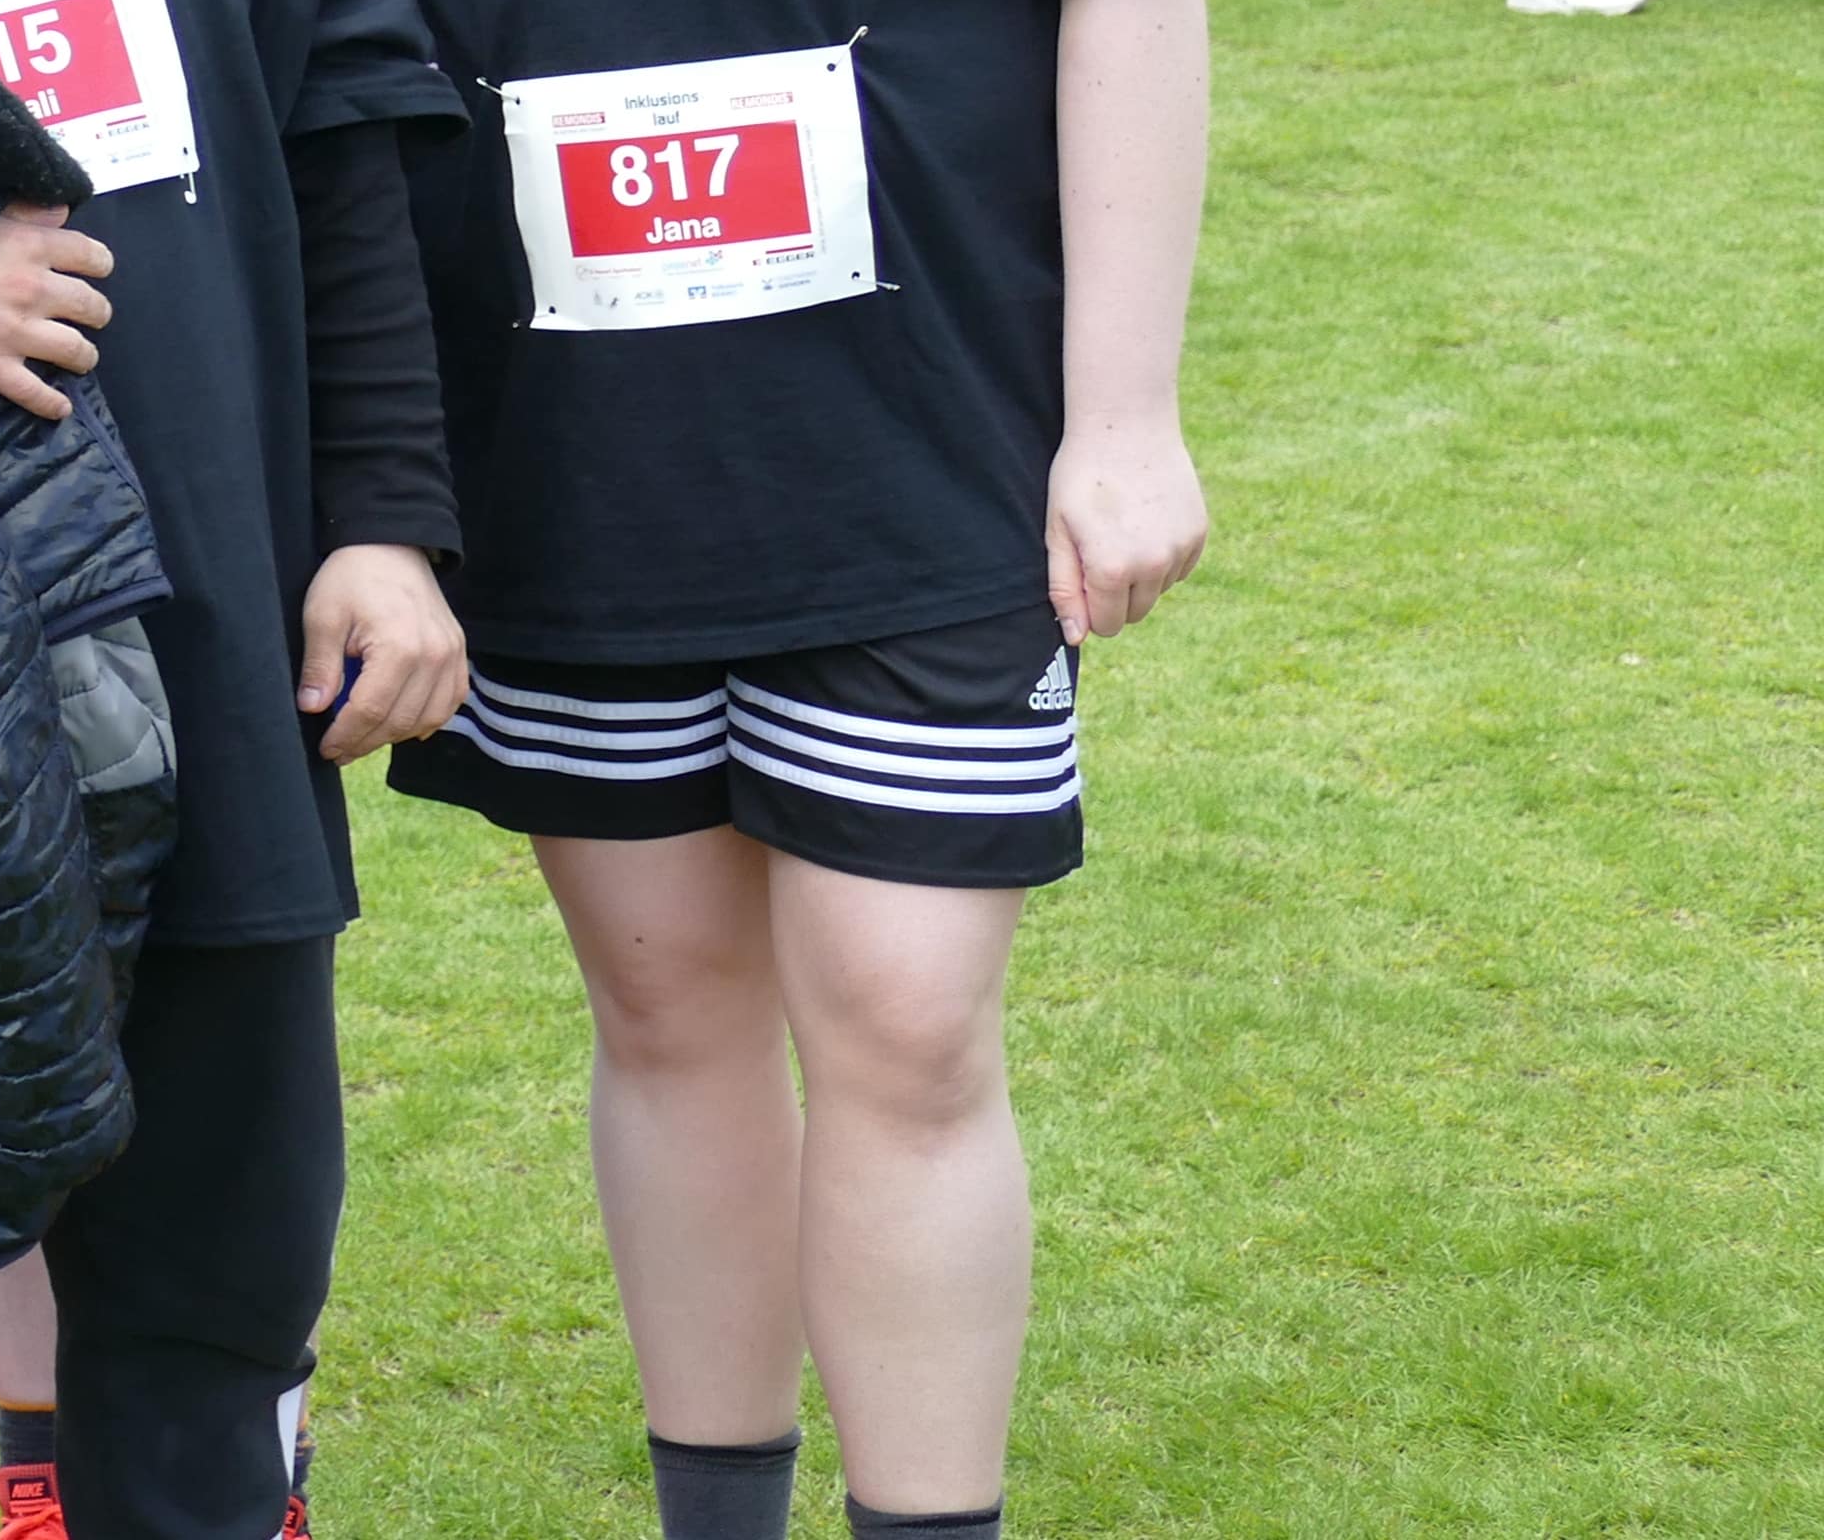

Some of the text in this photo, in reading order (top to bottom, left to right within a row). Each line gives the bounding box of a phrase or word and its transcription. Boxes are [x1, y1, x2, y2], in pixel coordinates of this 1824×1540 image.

[25, 89, 61, 119] ali
[653, 111, 680, 126] lauf
[610, 134, 740, 207] 817
[646, 216, 721, 245] Jana
[11, 1482, 45, 1498] NIKE
